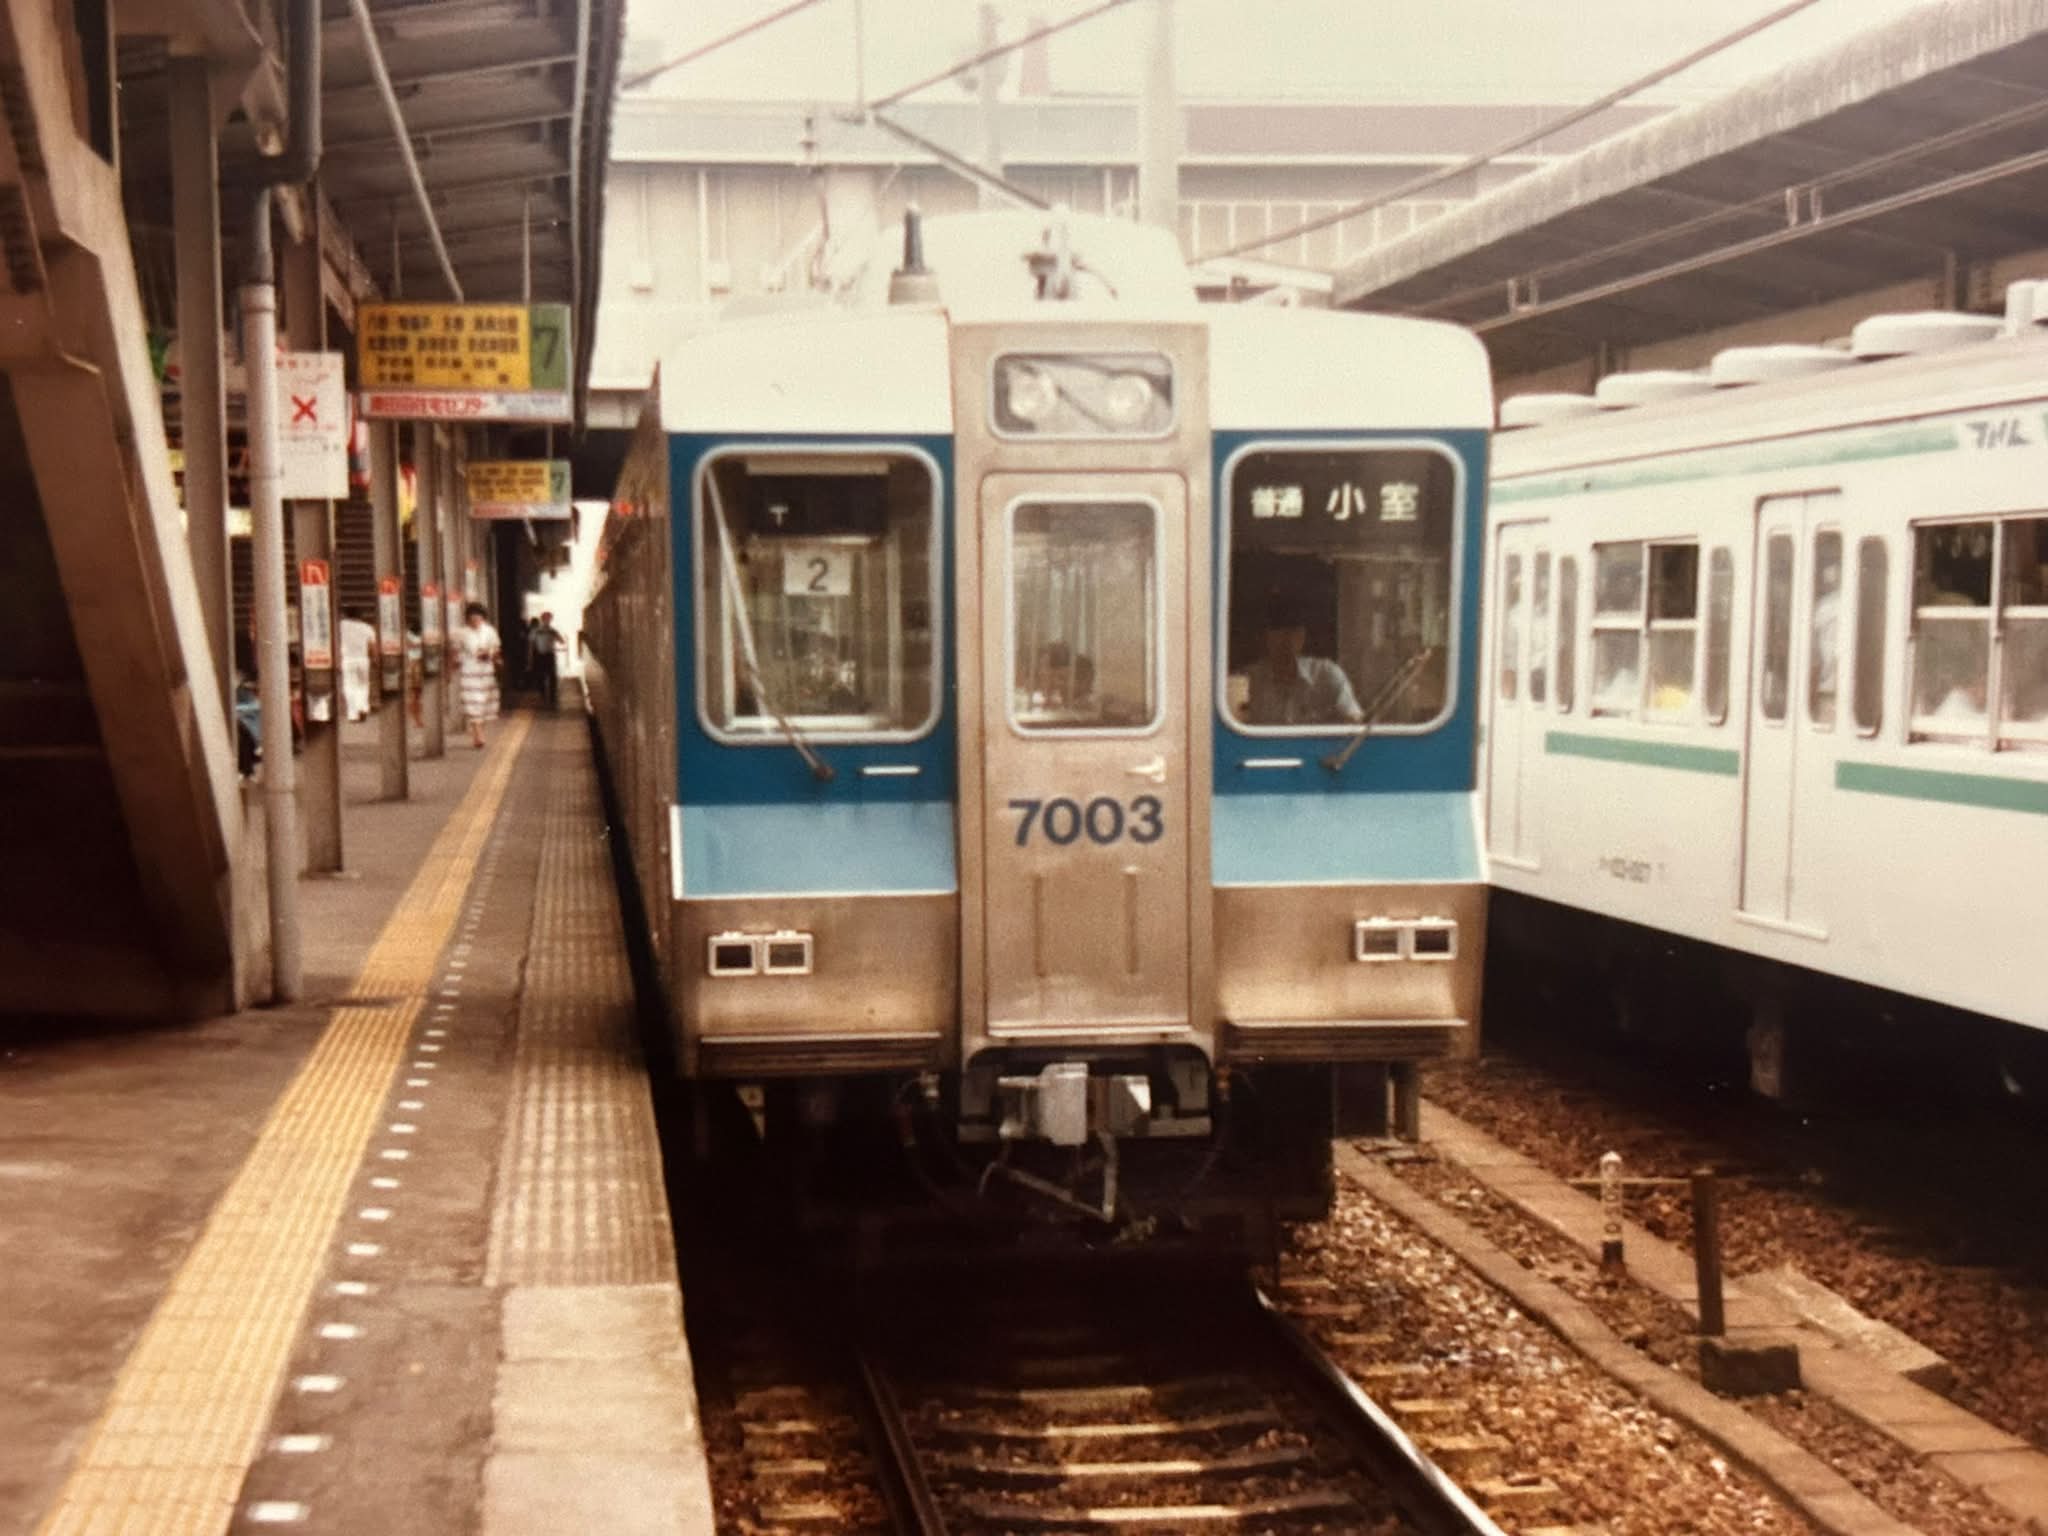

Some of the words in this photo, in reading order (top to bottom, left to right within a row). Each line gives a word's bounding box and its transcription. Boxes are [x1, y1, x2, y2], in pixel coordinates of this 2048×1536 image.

[533, 326, 559, 369] 7
[1326, 482, 1419, 521] 小室
[807, 557, 829, 591] 2
[1008, 794, 1164, 847] 7003
